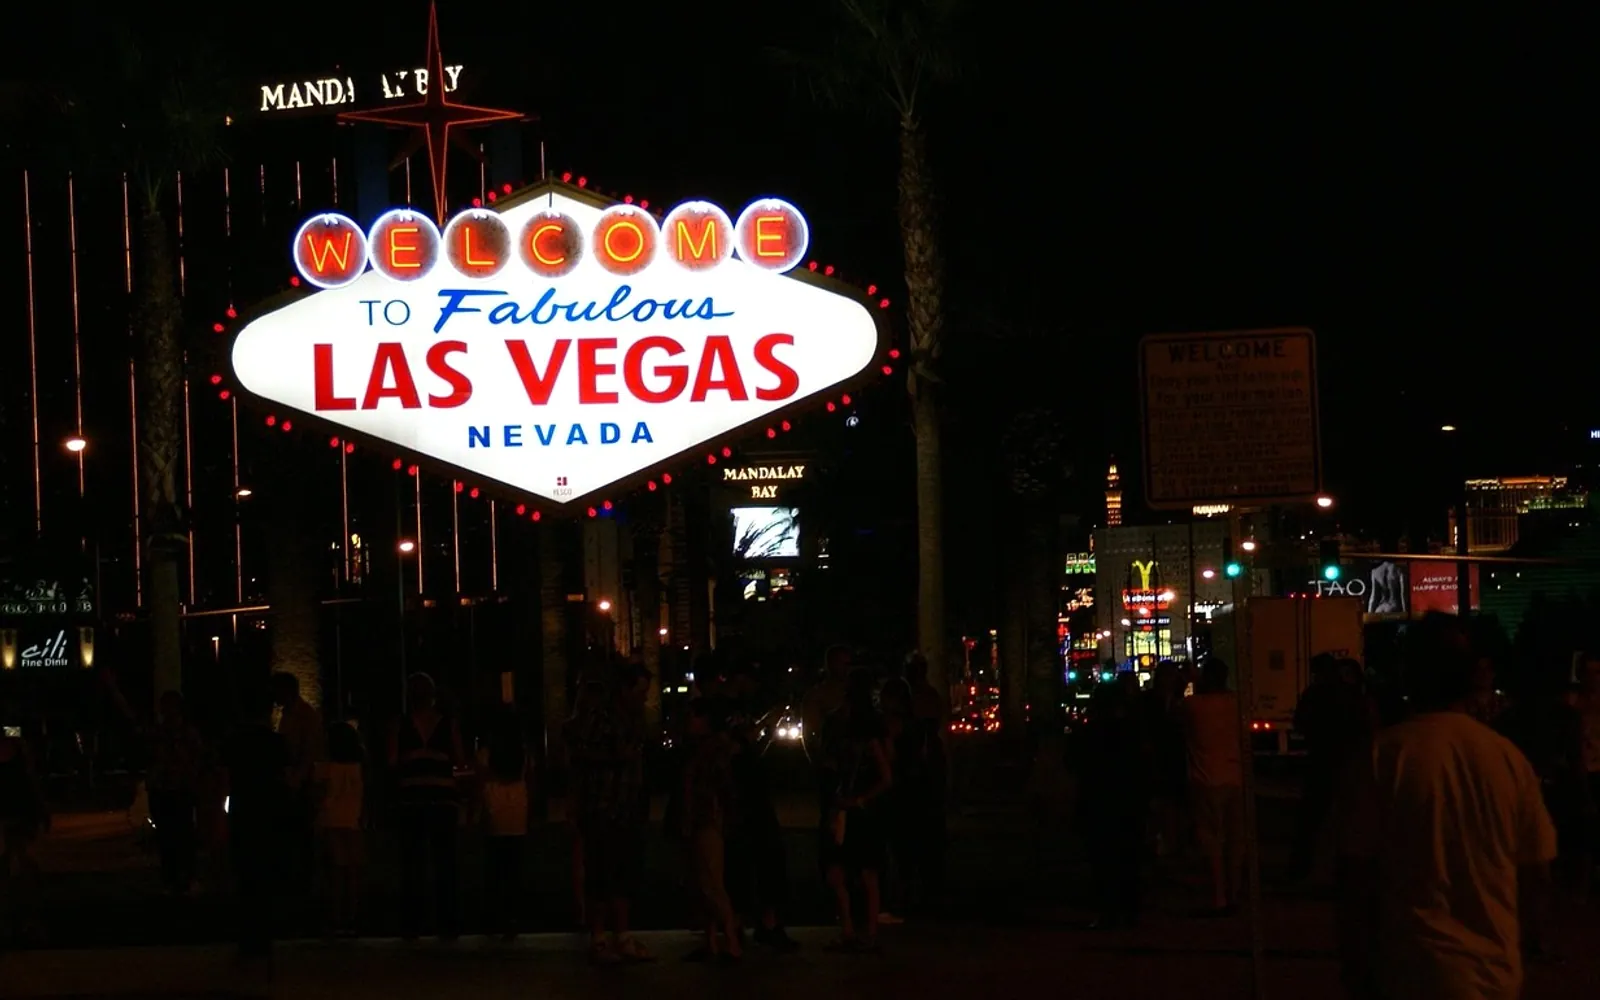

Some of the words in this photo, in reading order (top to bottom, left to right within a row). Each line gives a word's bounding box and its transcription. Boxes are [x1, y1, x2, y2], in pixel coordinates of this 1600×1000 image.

[414, 65, 463, 95] BY
[306, 215, 785, 272] WELCOME
[359, 299, 411, 326] TO
[433, 284, 735, 334] Fabulous
[1168, 339, 1287, 363] WELCOME
[313, 339, 473, 411] LAS
[504, 333, 800, 405] VEGAS
[468, 421, 654, 448] NEVADA
[723, 465, 805, 480] MANDALAY
[751, 485, 778, 498] BAY
[1308, 578, 1366, 597] TAO
[1412, 584, 1439, 592] HAPPY
[21, 659, 43, 668] Fine
